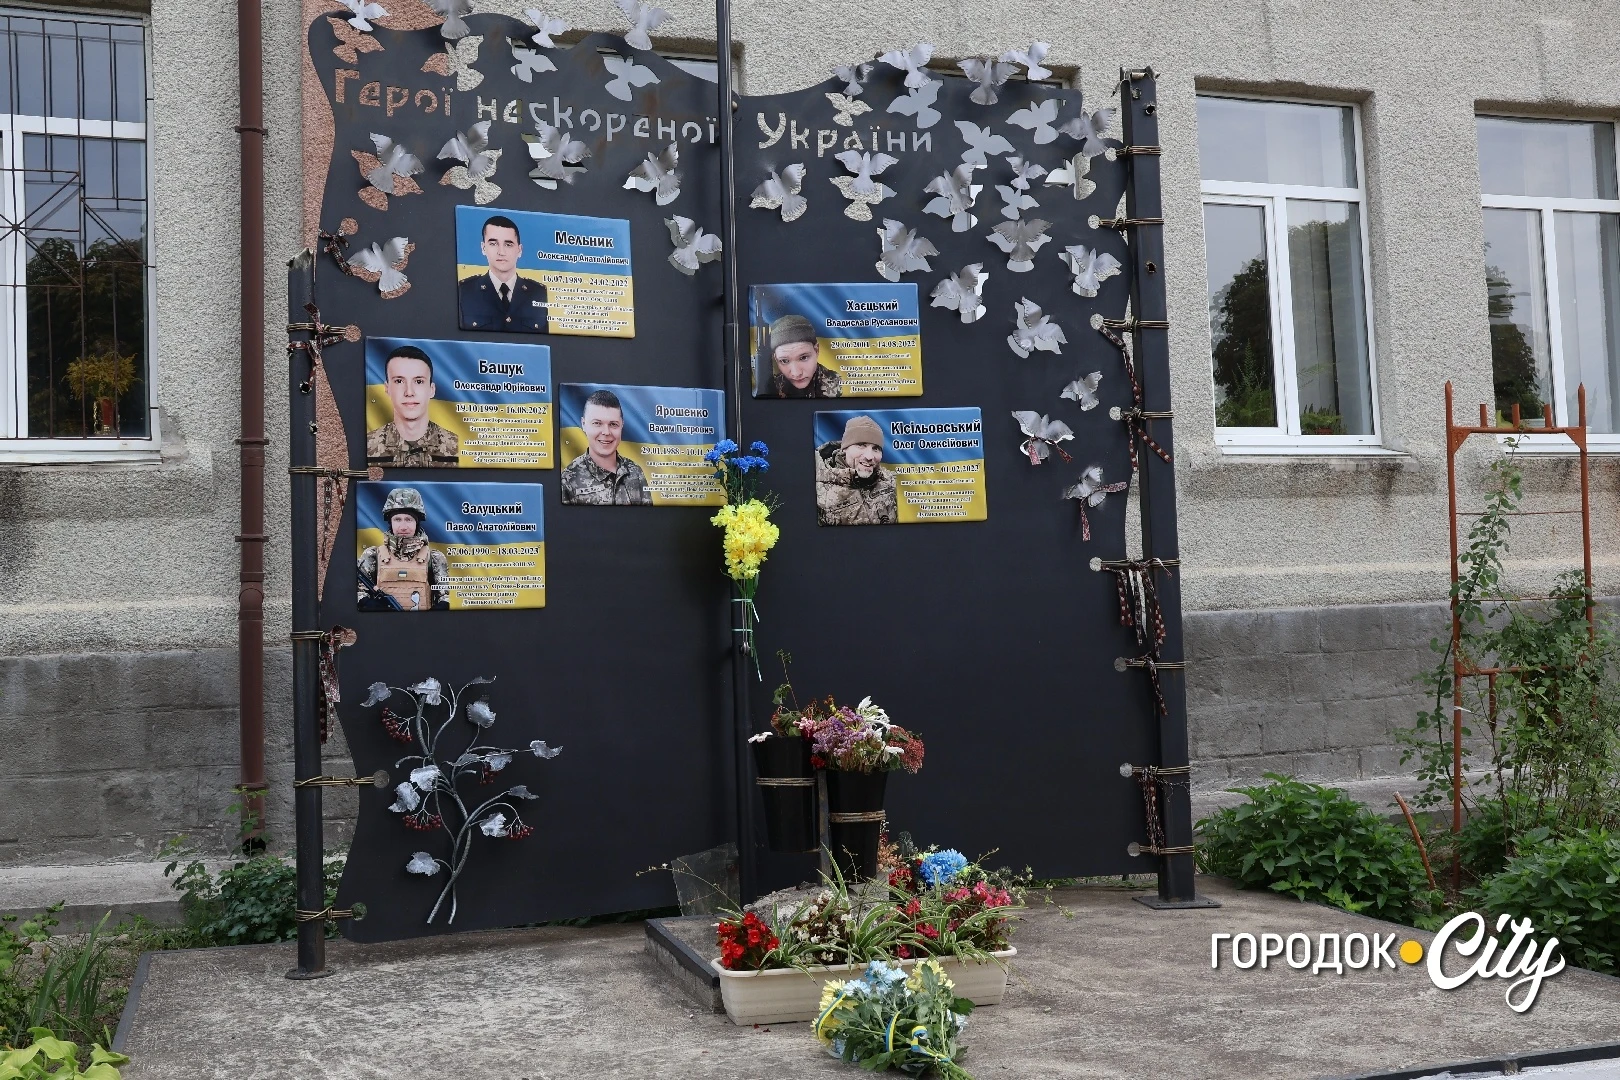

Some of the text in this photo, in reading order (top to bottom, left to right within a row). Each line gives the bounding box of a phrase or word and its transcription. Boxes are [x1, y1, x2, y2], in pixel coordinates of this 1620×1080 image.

[335, 69, 932, 158] Герої нескореної України
[555, 230, 614, 249] Мельник
[537, 251, 630, 266] Олександр Анатолійович
[543, 274, 583, 284] 16.07.1989
[589, 277, 628, 288] 24.02.2022
[846, 299, 899, 313] Хаєцький
[826, 318, 919, 328] Владислав Русланович
[877, 339, 916, 348] 14.08.2022
[454, 380, 546, 394] Олександр Юрійович
[456, 404, 499, 413] 19.10.1999
[506, 406, 547, 415] 16.08.2022
[655, 405, 709, 418] Ярошенко
[649, 422, 714, 435] Вадим Петрович
[641, 446, 680, 455] 29.01.1988
[893, 438, 979, 451] Олег Олексійович
[462, 501, 523, 517] Залуцький
[446, 521, 537, 532] Павло Анатолійович
[447, 547, 490, 556] 27.06.1990
[498, 547, 539, 555] 18.03.2023
